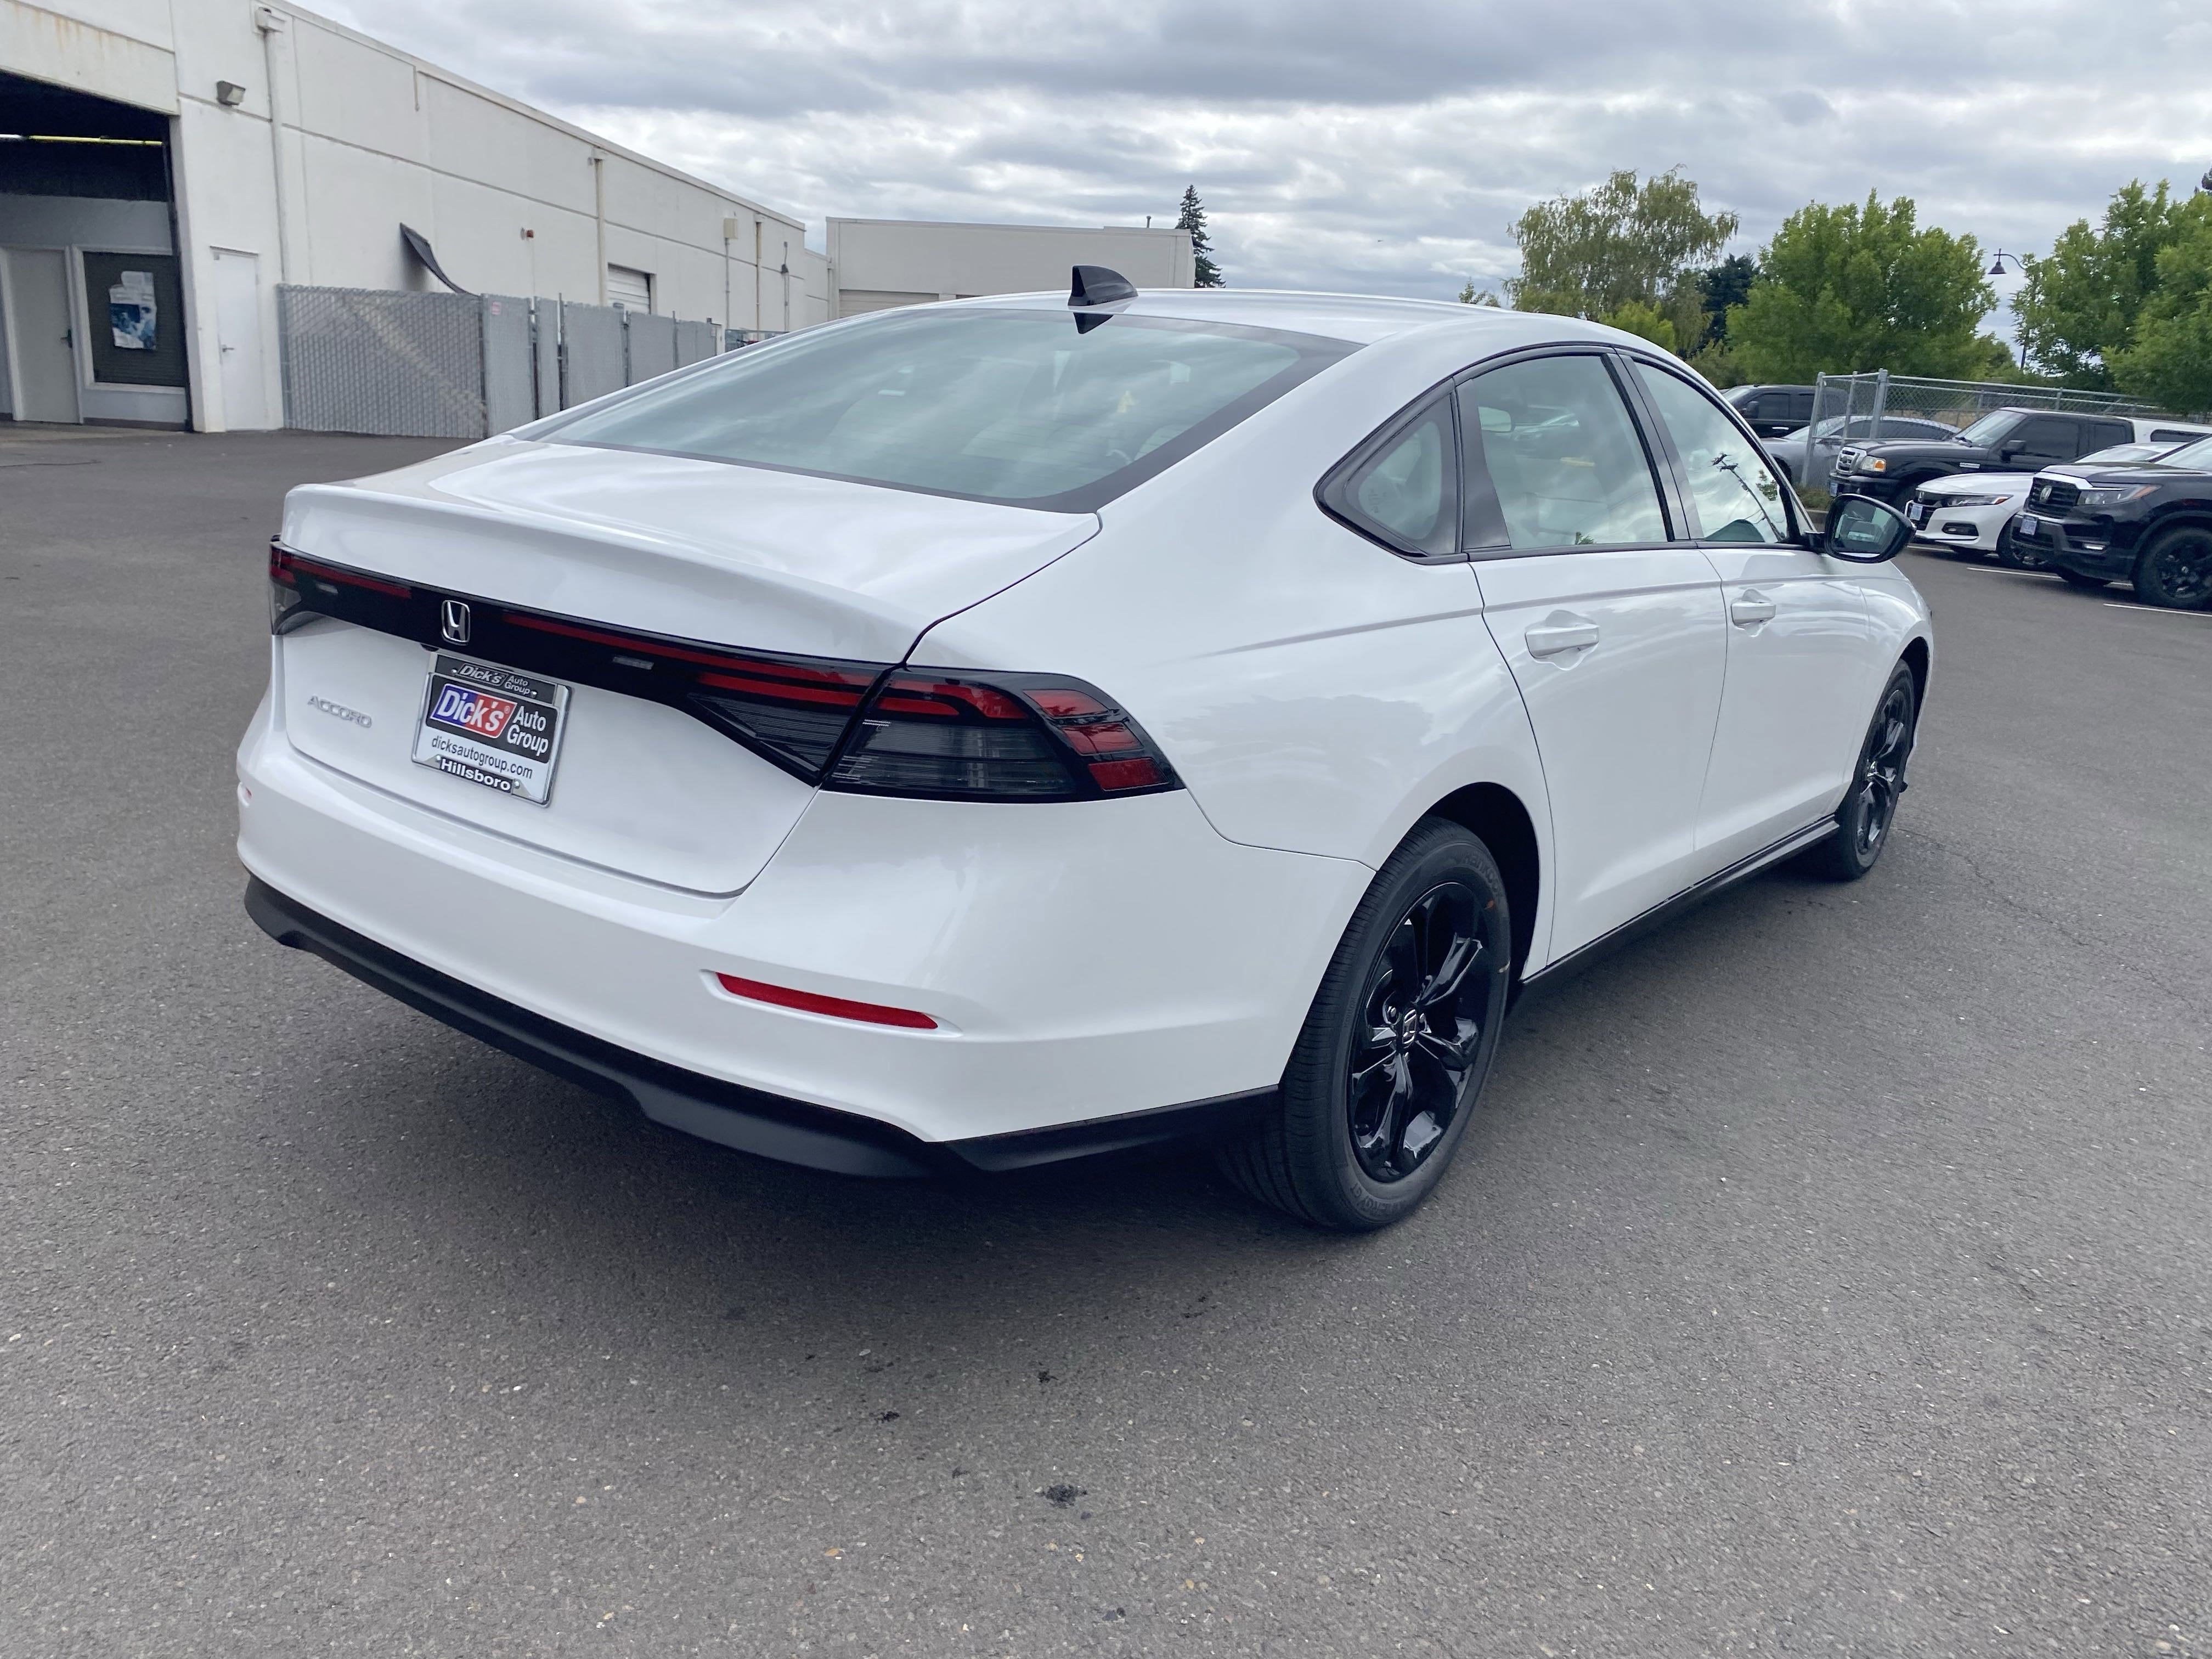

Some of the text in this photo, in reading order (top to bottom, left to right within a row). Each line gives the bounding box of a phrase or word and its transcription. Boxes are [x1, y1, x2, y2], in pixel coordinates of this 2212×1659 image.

[459, 665, 503, 684] Dick's
[505, 682, 530, 695] Group
[507, 675, 528, 686] Auto
[307, 695, 372, 728] ACCORD
[437, 690, 504, 731] Dick's
[512, 706, 546, 731] Auto
[507, 724, 549, 756] Group
[432, 735, 533, 779] dicksautogroup.com
[441, 758, 511, 791] Hillsboro
